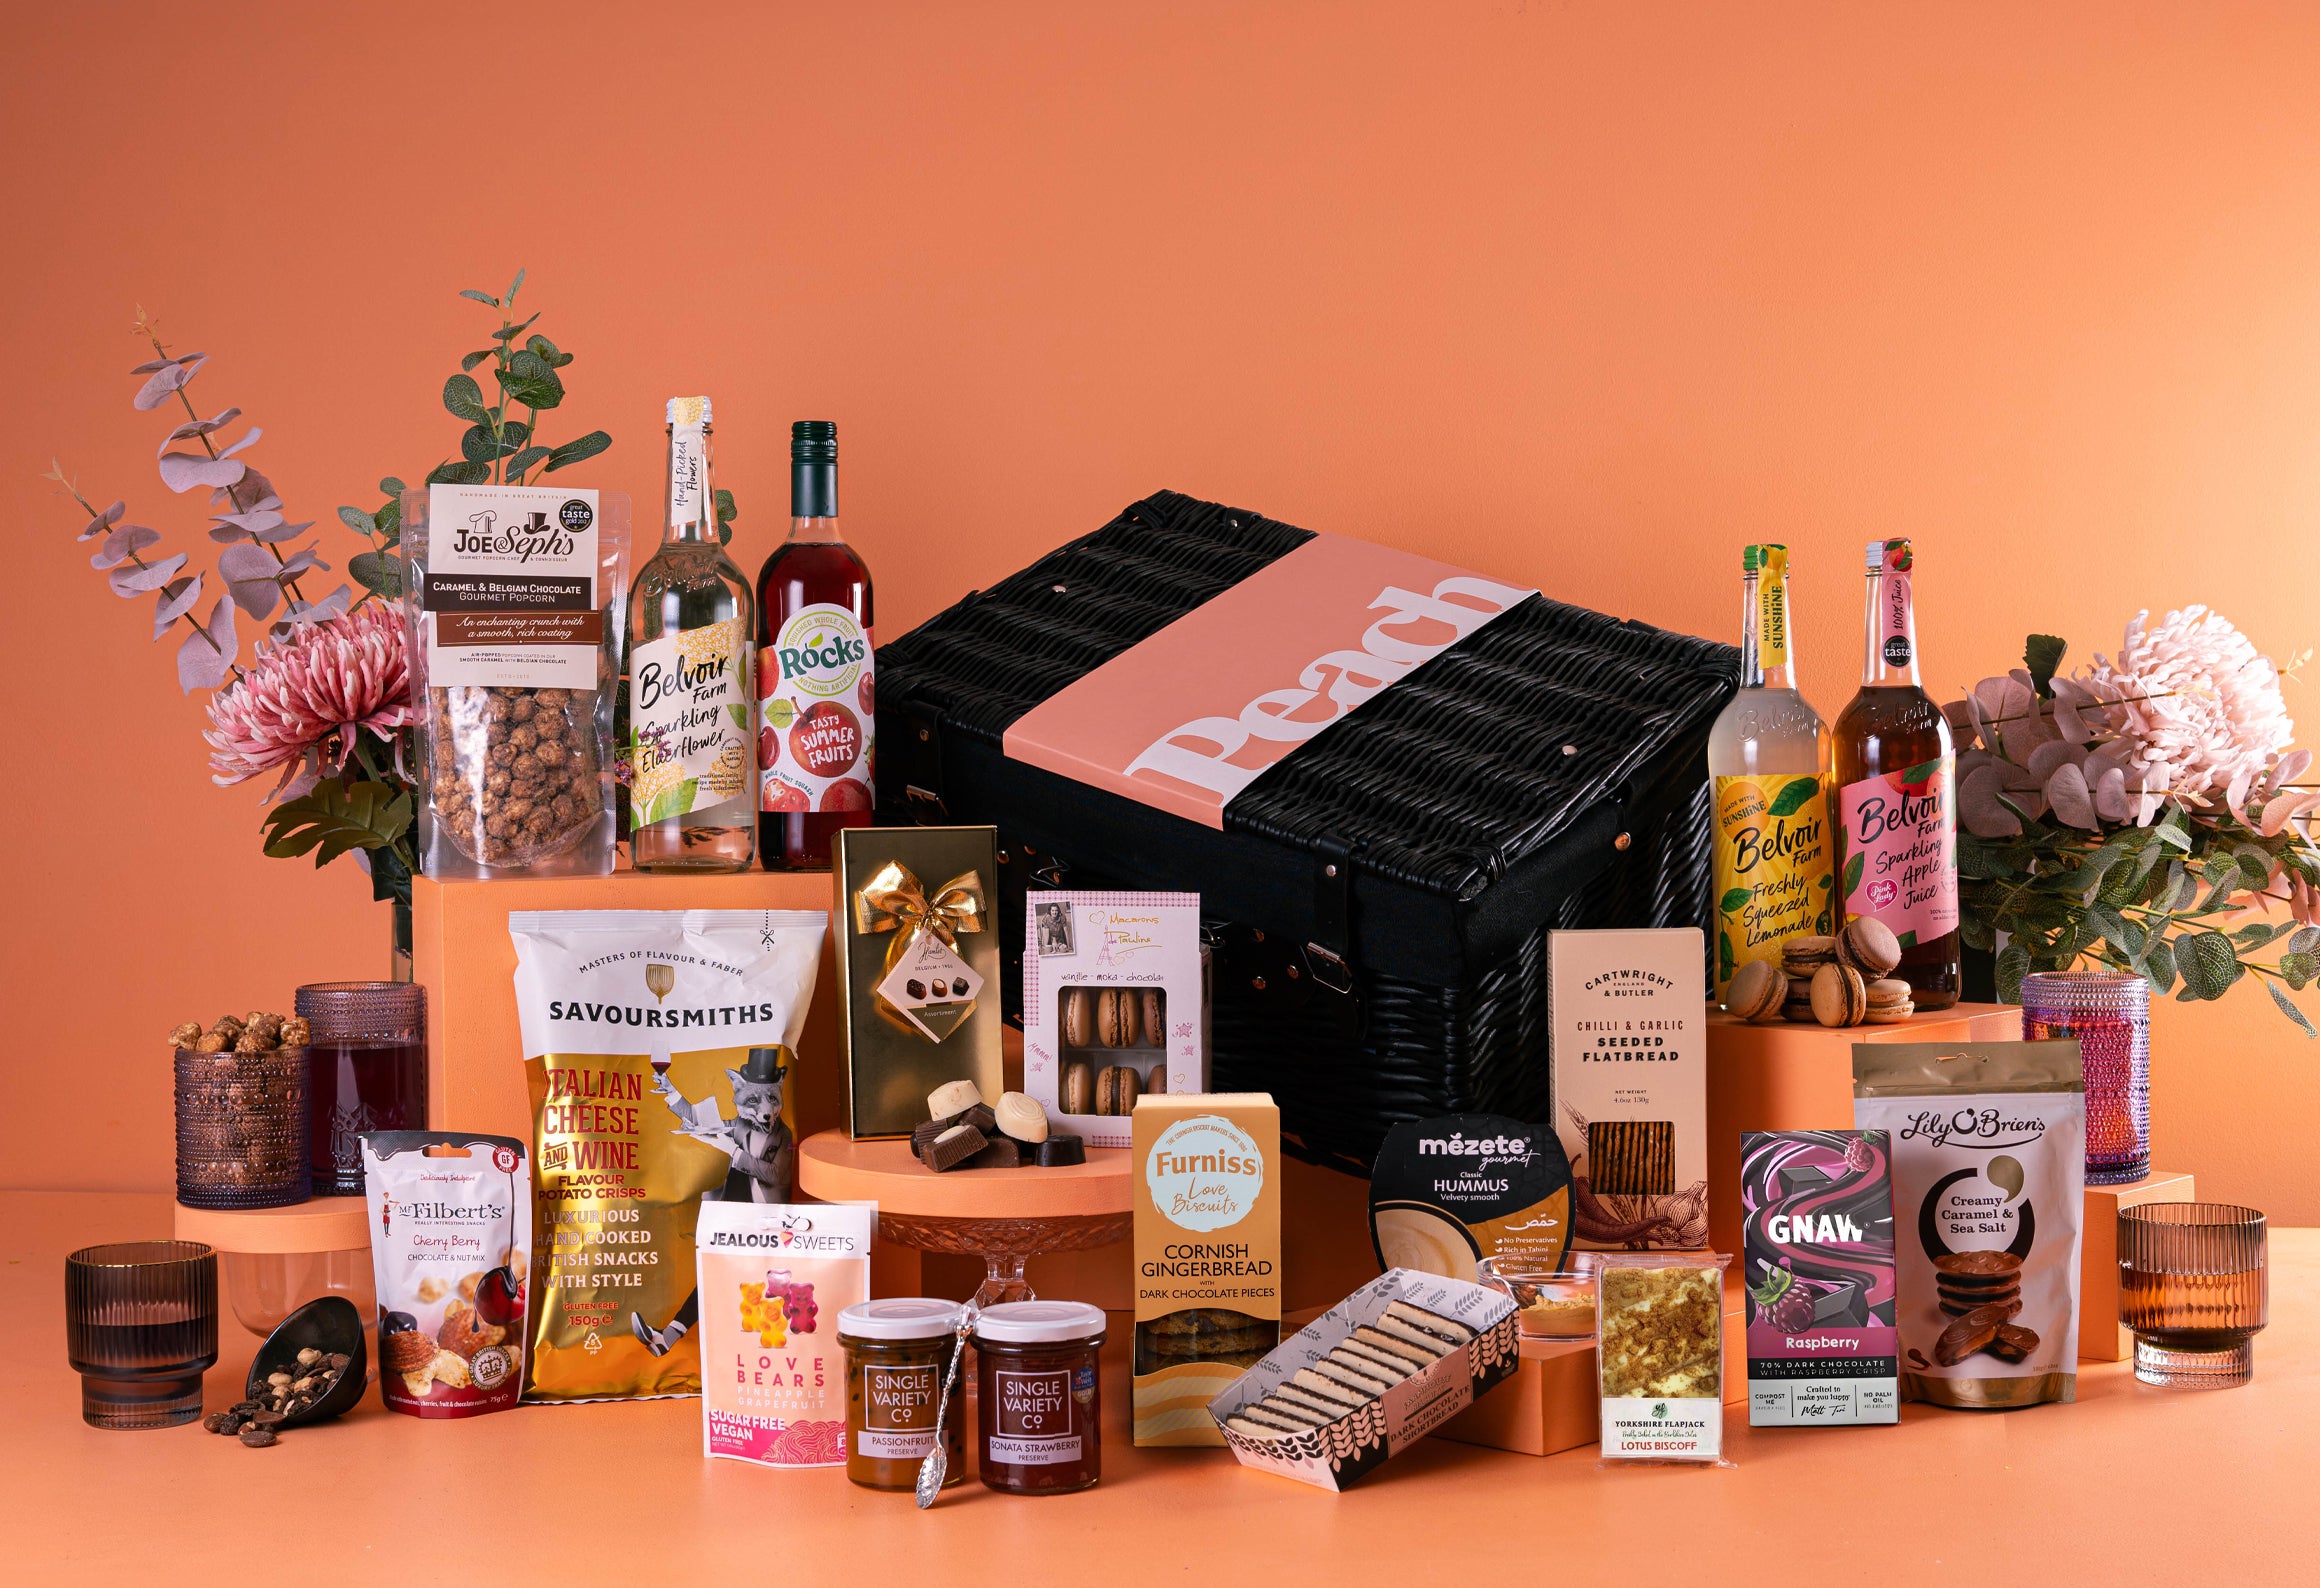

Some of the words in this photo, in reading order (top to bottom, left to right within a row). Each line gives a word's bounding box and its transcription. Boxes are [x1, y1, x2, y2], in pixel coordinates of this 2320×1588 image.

[674, 441, 689, 506] Hand-Picked
[687, 456, 698, 491] Flowers
[562, 510, 590, 519] taste
[433, 582, 477, 592] CARAMEL
[479, 583, 487, 592] &
[489, 583, 528, 593] BELGIAN
[529, 584, 581, 594] CHOCOLATE
[1891, 579, 1904, 603] Juice
[459, 592, 506, 602] GOURMET
[509, 593, 555, 603] POPCORN
[457, 616, 476, 627] An
[477, 618, 527, 628] enchanting
[528, 617, 561, 626] crunch
[562, 615, 584, 626] with
[1893, 604, 1904, 630] 100%
[477, 626, 514, 638] smooth,
[517, 627, 536, 637] rich
[537, 626, 573, 640] coating
[778, 636, 865, 680] Rocks
[1885, 648, 1912, 657] taste
[639, 653, 728, 710] Belvoir
[799, 677, 829, 693] NOTHING
[831, 664, 858, 691] ARTIFICIAL
[692, 682, 727, 704] Farm
[1122, 576, 1543, 808] Peach
[644, 704, 722, 749] Sparkling
[810, 715, 840, 730] TASTY
[800, 727, 855, 751] SUMMER
[807, 744, 854, 769] FRUITS
[1724, 801, 1739, 813] MADE
[1738, 795, 1756, 806] WITH
[1733, 817, 1823, 874] Belvoir
[1792, 844, 1822, 868] Farm
[1875, 838, 1942, 875] Sparkling
[1902, 859, 1940, 888] Apple
[1753, 873, 1808, 902] Freshly
[1870, 882, 1892, 898] Pink
[1873, 892, 1896, 904] Lady
[1903, 884, 1939, 910] Juice
[1743, 887, 1810, 929] Squeezed
[1109, 912, 1160, 925] Macarons
[1745, 910, 1815, 948] Lemonade
[579, 952, 625, 974] MASTERS
[629, 951, 643, 959] OF
[646, 951, 696, 964] FLAVOUR
[711, 960, 744, 977] FABER
[1061, 971, 1088, 982] vanille
[1096, 973, 1118, 981] moka
[1126, 971, 1164, 982] chocolat
[1585, 969, 1674, 991] CARTWRIGHT
[1614, 989, 1654, 997] BUTLER
[549, 1001, 774, 1028] SAVOURSMITHS
[923, 1009, 957, 1018] Assortment
[1577, 1020, 1618, 1031] CHILLI
[1625, 1021, 1632, 1031] &
[1639, 1020, 1684, 1031] GARLIC
[1597, 1037, 1664, 1047] SEEDED
[1583, 1051, 1679, 1062] FLATBREAD
[542, 1068, 642, 1102] ITALIAN
[543, 1104, 639, 1135] CHEESE
[1900, 1111, 1954, 1148] Lily
[543, 1145, 568, 1168] AND
[572, 1141, 639, 1170] WINE
[1156, 1148, 1257, 1177] Furniss
[1478, 1149, 1542, 1171] gourmet
[557, 1174, 625, 1186] FLAVOUR
[1188, 1176, 1228, 1200] Love
[1434, 1179, 1509, 1192] HUMMUS
[538, 1188, 592, 1201] POTATO
[595, 1187, 646, 1199] CRISPS
[1440, 1193, 1469, 1203] Velvety
[1469, 1193, 1500, 1201] smooth
[1951, 1196, 2003, 1208] Creamy
[1171, 1193, 1238, 1216] Biscuits
[544, 1209, 640, 1225] LUXURIOUS
[1941, 1208, 1998, 1220] Caramel
[2002, 1208, 2014, 1219] &
[1768, 1214, 1863, 1244] GNAW
[1950, 1223, 1975, 1234] Sea
[1978, 1222, 2007, 1233] Salt
[413, 1235, 448, 1251] Cherry
[451, 1235, 481, 1251] Berry
[536, 1232, 580, 1247] HAND
[585, 1230, 652, 1245] COOKED
[709, 1232, 779, 1249] JEALOUS
[793, 1235, 855, 1251] SWEETS
[407, 1253, 449, 1262] CHOCOLATE
[450, 1254, 456, 1262] &
[456, 1254, 471, 1262] NUT
[471, 1254, 486, 1262] MIX
[531, 1253, 589, 1268] BRITISH
[594, 1251, 659, 1266] SNACKS
[1164, 1243, 1249, 1260] CORNISH
[1141, 1260, 1273, 1278] GINGERBREAD
[542, 1275, 587, 1289] WITH
[591, 1273, 643, 1288] STYLE
[1140, 1289, 1170, 1299] DARK
[1171, 1288, 1239, 1299] CHOCOLATE
[1240, 1287, 1275, 1298] PIECES
[563, 1302, 597, 1311] GLUTEN
[598, 1302, 619, 1310] FREE
[569, 1315, 600, 1328] 150g
[1786, 1336, 1860, 1351] Raspberry
[737, 1353, 824, 1371] LOVE
[737, 1370, 825, 1387] BEARS
[875, 1374, 929, 1390] SINGLE
[737, 1387, 825, 1399] PINEAPPLE
[1006, 1380, 1060, 1396] SINGLE
[737, 1398, 825, 1409] GRAPEFRUIT
[872, 1390, 932, 1407] VARIETY
[1003, 1396, 1063, 1412] VARIETY
[1390, 1423, 1415, 1442] DARK
[1417, 1384, 1471, 1425] CHOCOLATE
[1801, 1404, 1827, 1417] Matt
[710, 1408, 754, 1428] SUGAR
[752, 1416, 786, 1431] FREE
[1402, 1402, 1459, 1444] SHORTBREAD
[1615, 1420, 1665, 1428] YORKSHIRE
[1665, 1420, 1705, 1429] FLAPJACK
[711, 1422, 754, 1441] VEGAN
[872, 1436, 934, 1446] PASSIONFRUIT
[991, 1440, 1023, 1453] SONATA
[1025, 1440, 1080, 1453] STRAWBERRY
[1621, 1441, 1653, 1451] LOTUS
[1654, 1441, 1698, 1451] BISCOFF
[887, 1448, 919, 1456] PRESERVE
